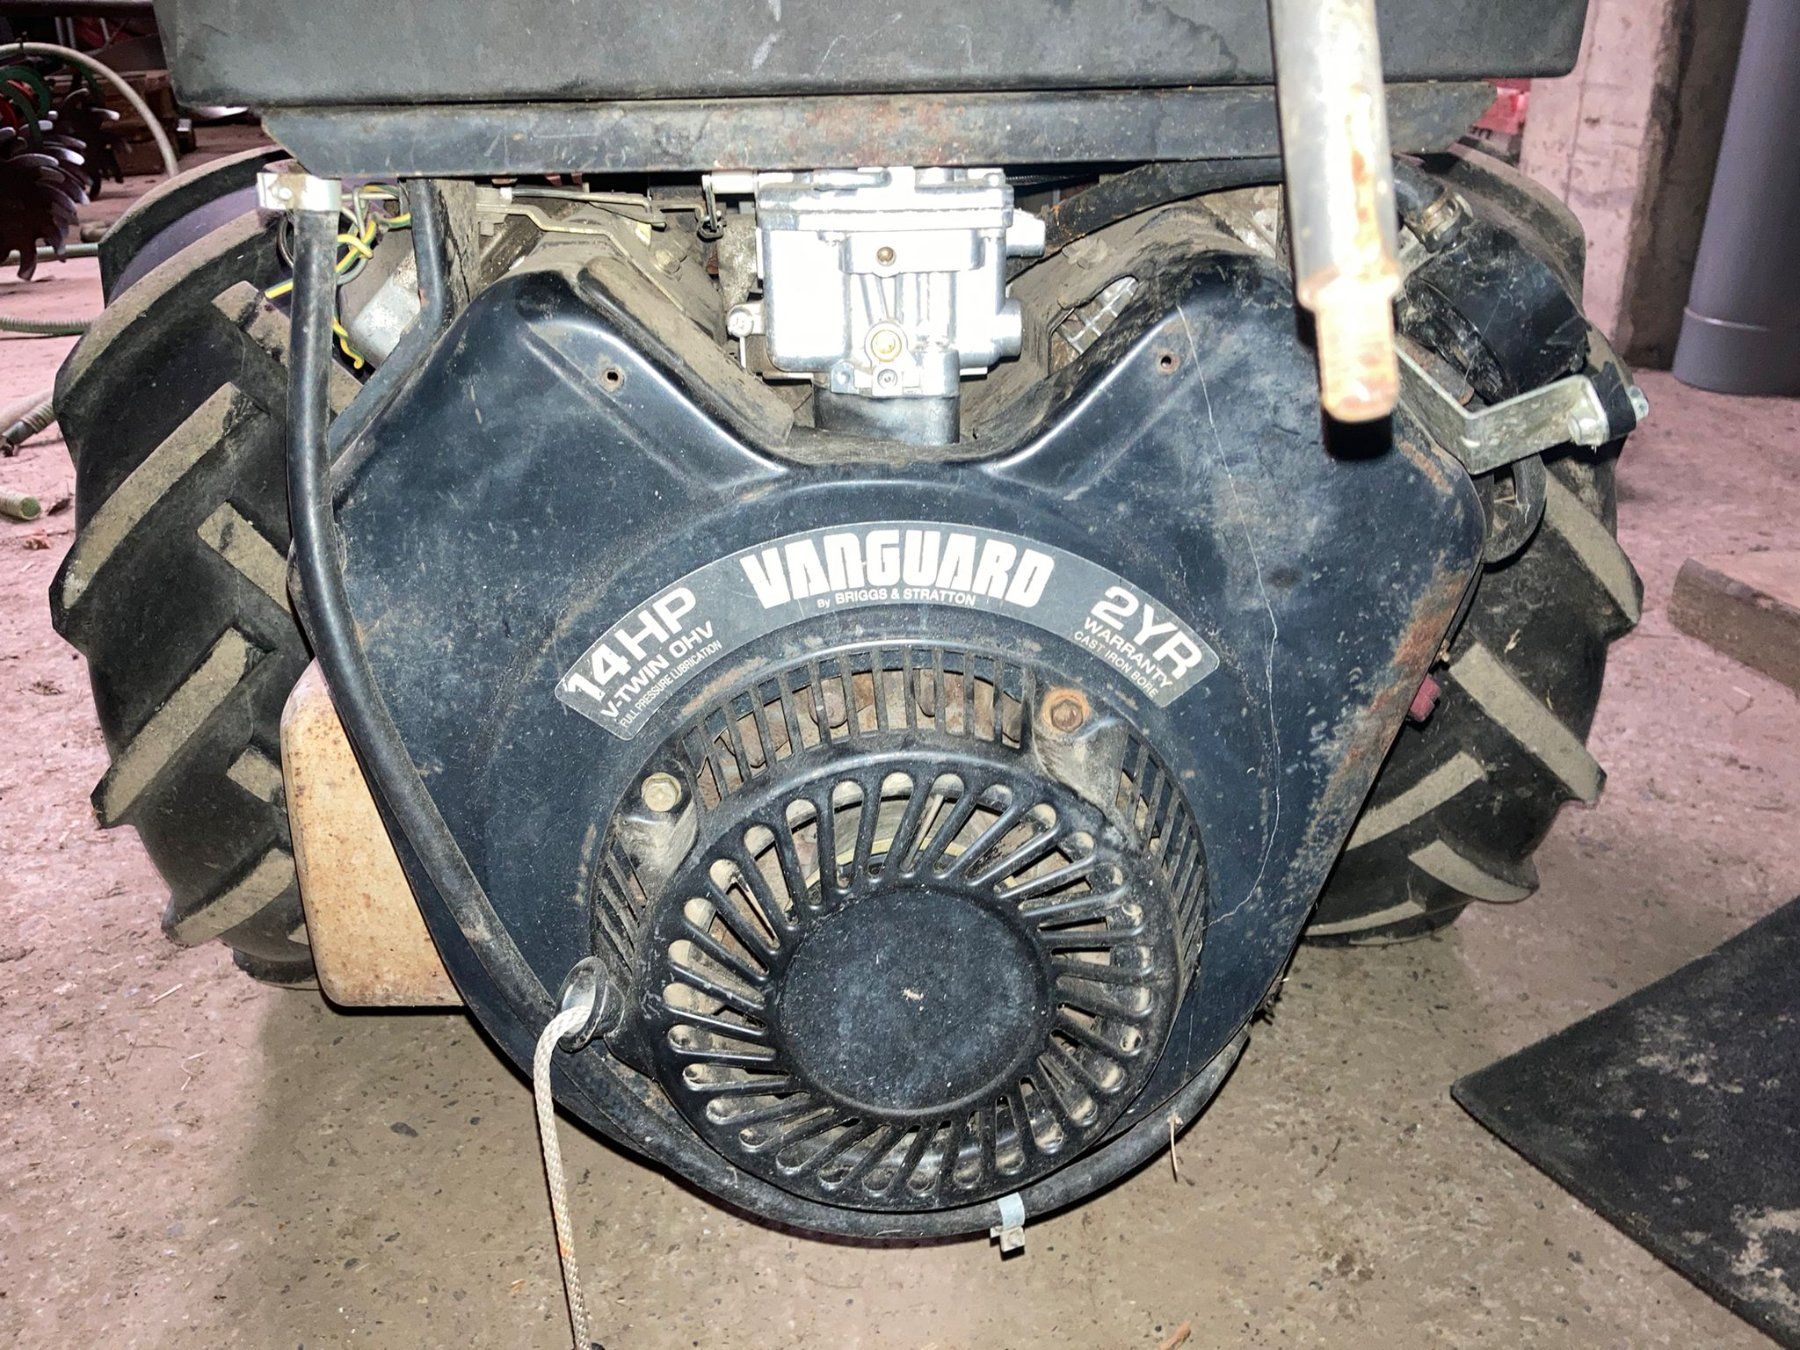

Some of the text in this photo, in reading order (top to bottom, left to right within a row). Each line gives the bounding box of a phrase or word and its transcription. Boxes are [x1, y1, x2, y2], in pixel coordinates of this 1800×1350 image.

[740, 529, 1055, 609] VANGUARD
[817, 588, 977, 609] By BRIGGS & STRATTON
[601, 620, 713, 718] V-TWIN OHV
[1074, 631, 1159, 698] CAST IRON BORE
[1084, 617, 1173, 689] WARRANTY
[1091, 585, 1203, 680] 2YR
[620, 640, 722, 727] FULL PRESSURE LUBRICATION
